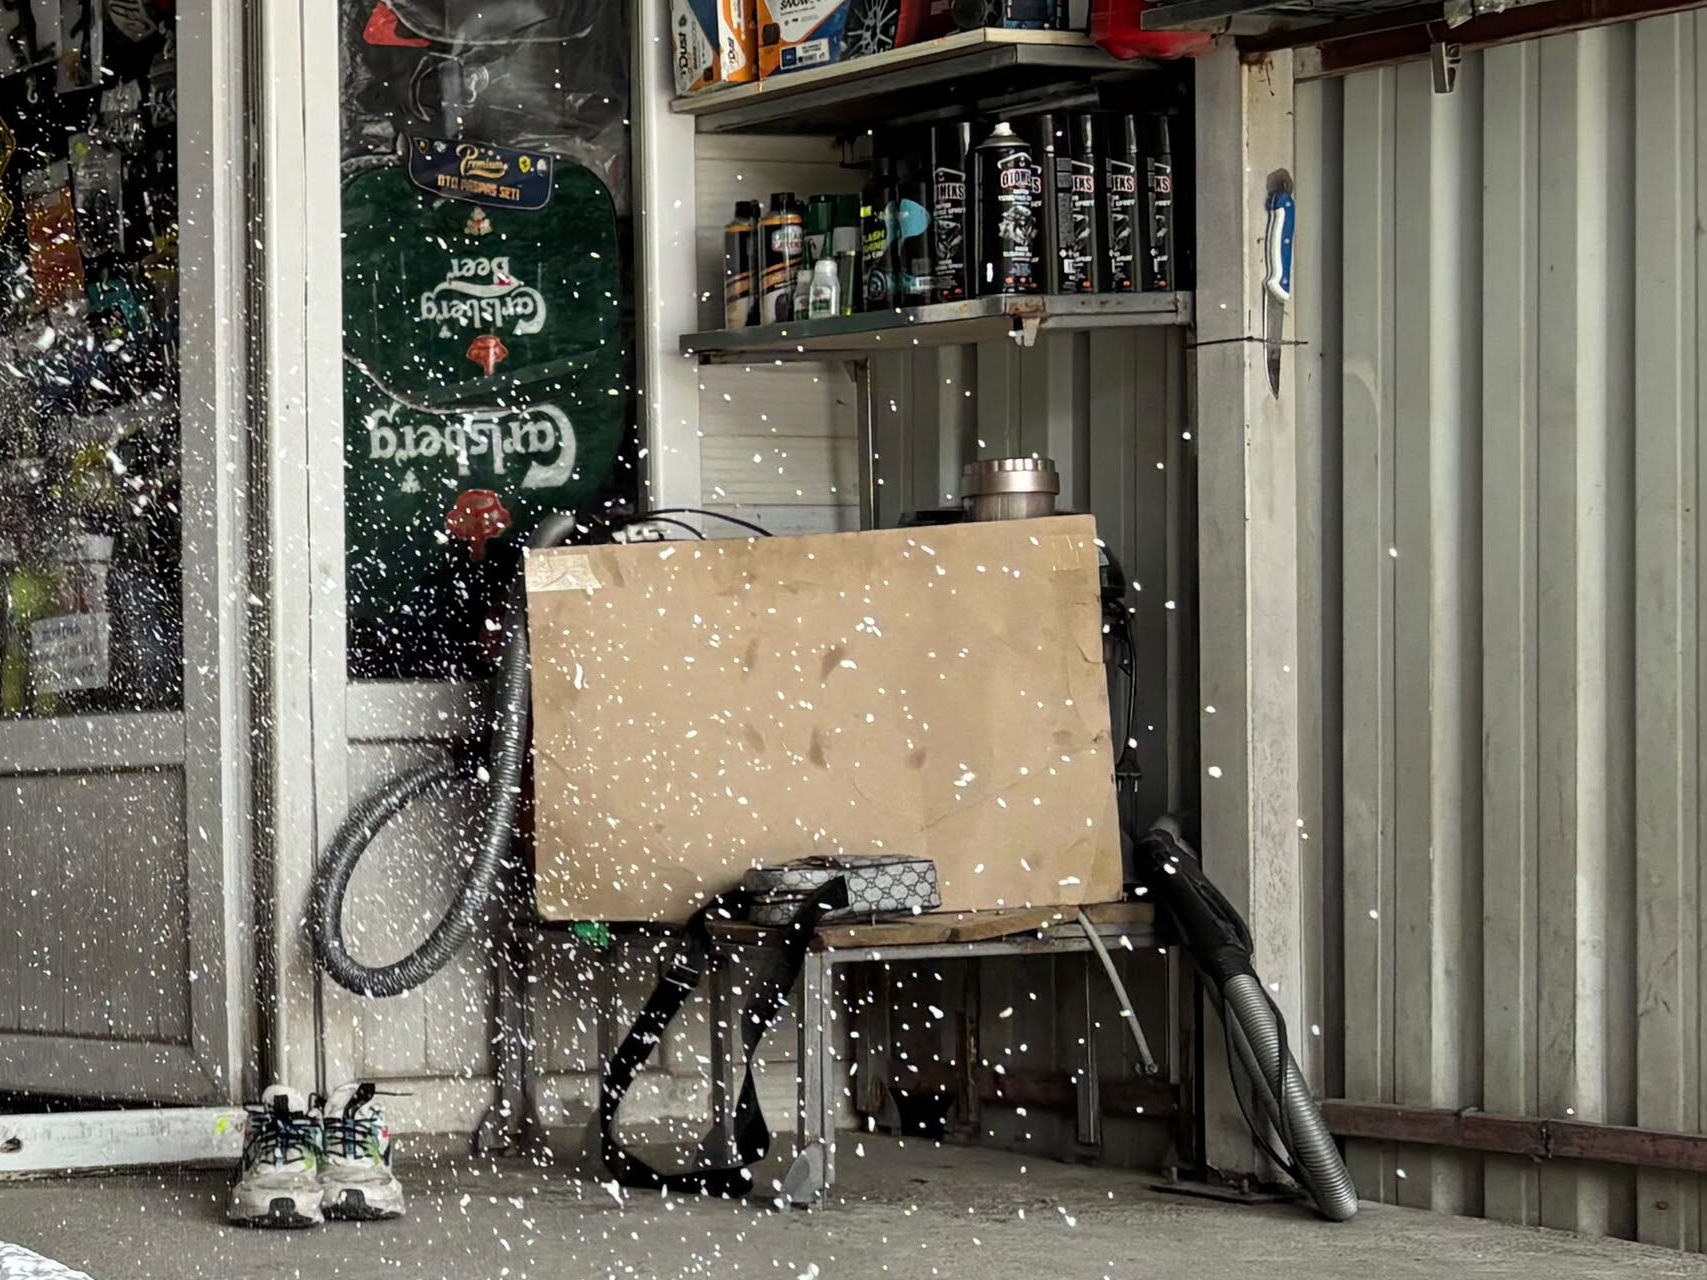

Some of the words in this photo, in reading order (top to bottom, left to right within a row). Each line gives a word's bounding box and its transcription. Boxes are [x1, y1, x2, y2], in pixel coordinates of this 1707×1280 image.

[445, 256, 511, 284] Beer
[421, 282, 547, 335] Carlsberg
[369, 403, 577, 489] Carlsberg
